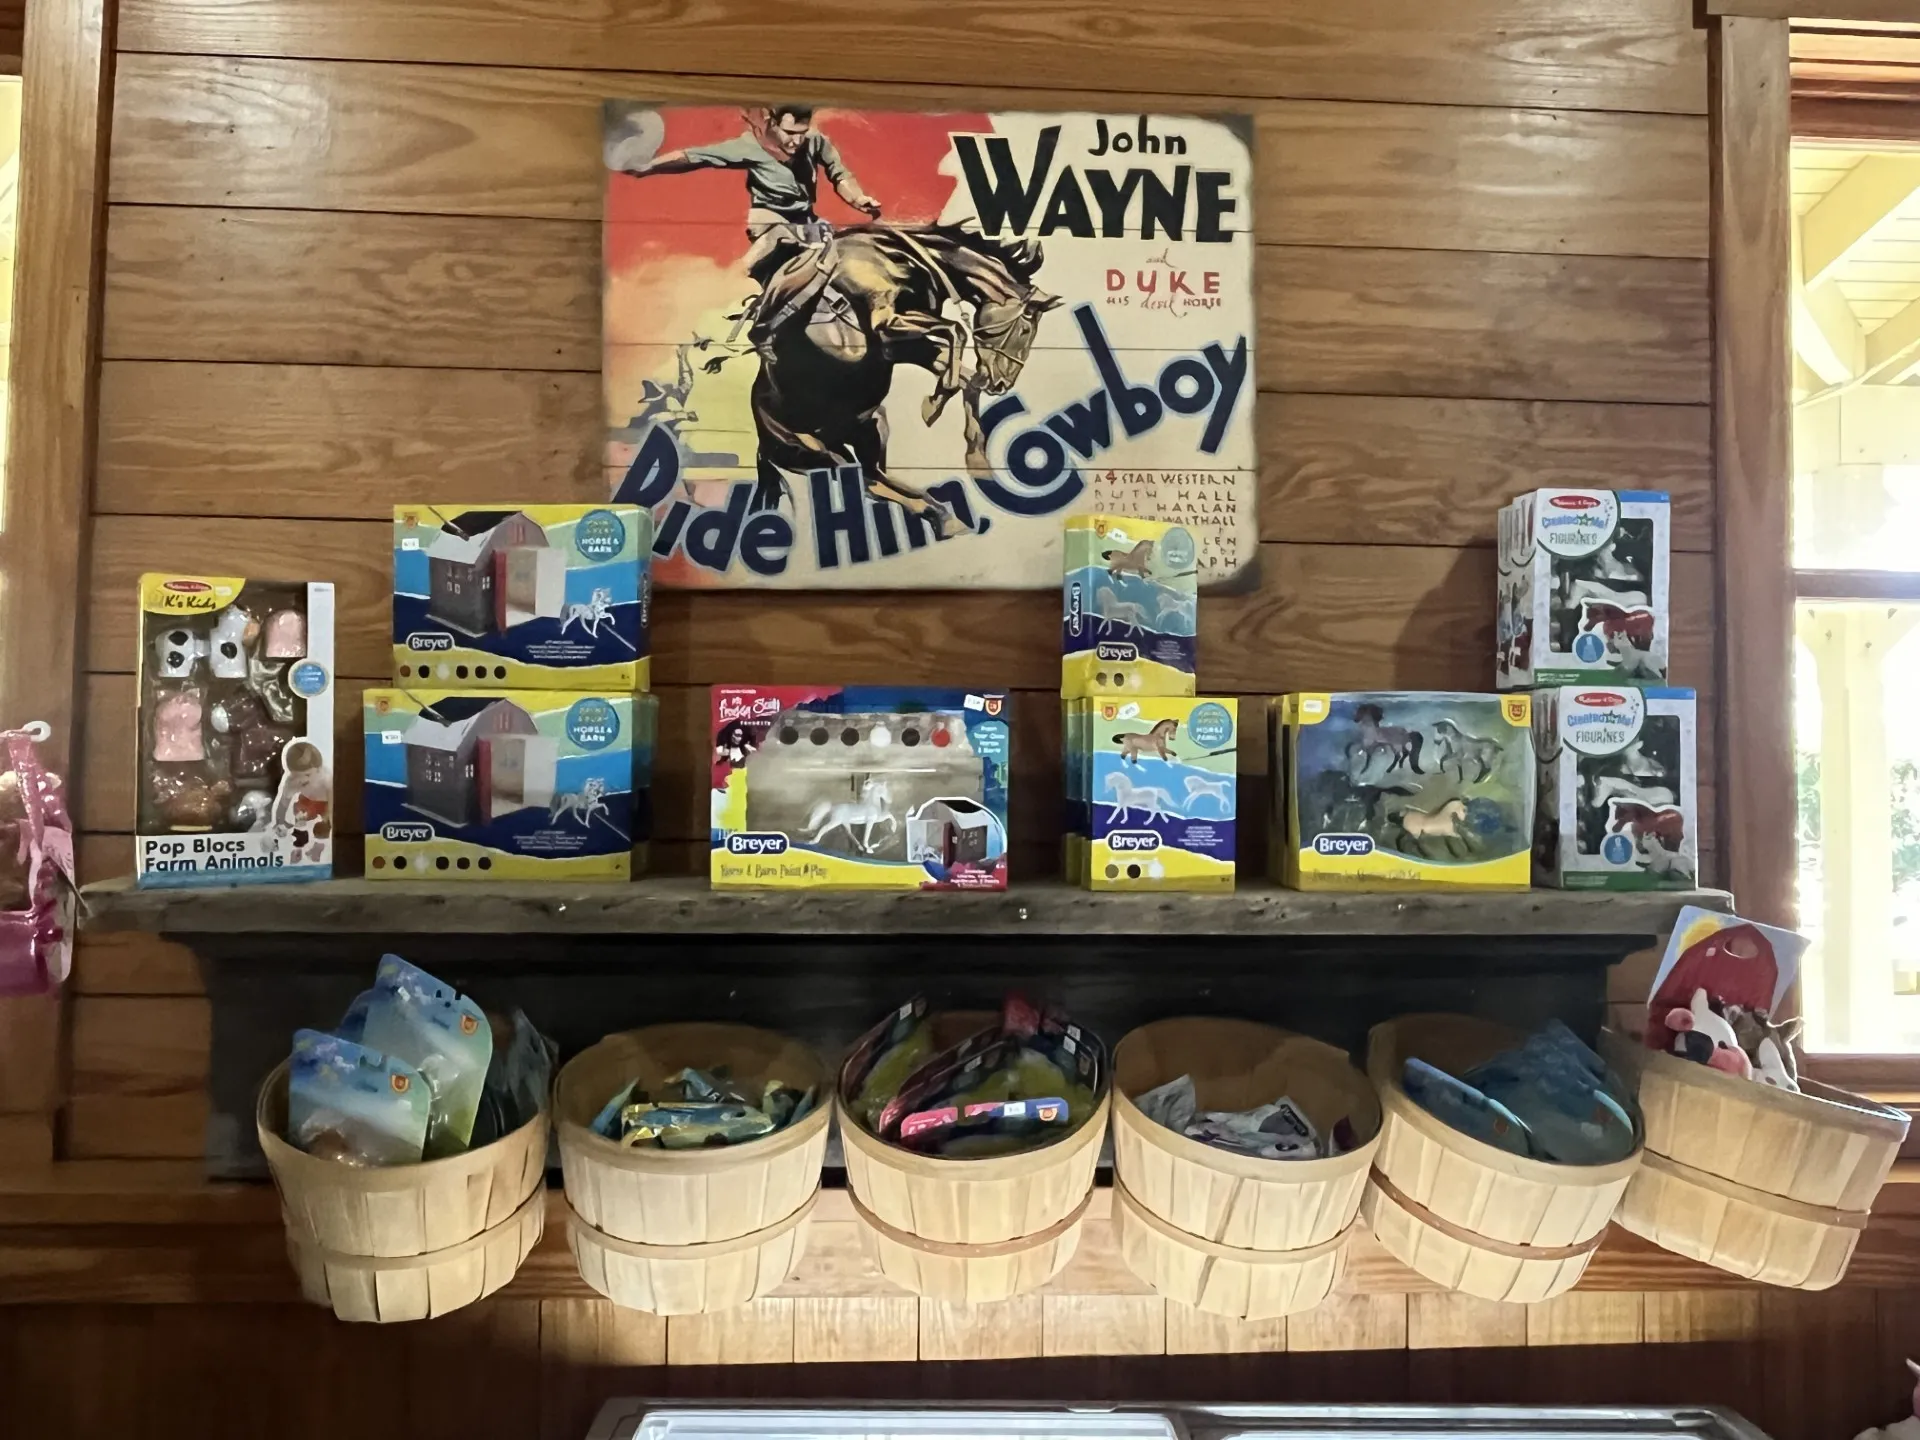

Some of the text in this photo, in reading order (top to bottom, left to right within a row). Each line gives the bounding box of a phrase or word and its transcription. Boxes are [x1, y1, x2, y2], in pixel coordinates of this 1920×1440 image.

[1087, 114, 1188, 157] John
[952, 125, 1237, 243] WAYNE
[1106, 269, 1221, 296] DUKE
[1106, 296, 1130, 306] HIS
[1183, 297, 1222, 310] HORSE
[972, 304, 1248, 516] Cowboy
[1094, 469, 1236, 486] A 4 STAR WESTERN
[1177, 490, 1237, 502] HALL
[1156, 503, 1237, 514] HARLAN
[186, 595, 217, 610] Kids
[411, 636, 450, 651] Breyer
[1099, 645, 1134, 661] Breyer
[1575, 727, 1625, 744] FIGURINES
[386, 826, 430, 842] Breyer
[1112, 835, 1157, 850] Breyer
[145, 837, 245, 858] Pop Blocs
[732, 836, 784, 855] Breyer
[1319, 837, 1369, 855] Breyer
[145, 851, 284, 873] Farm Animals
